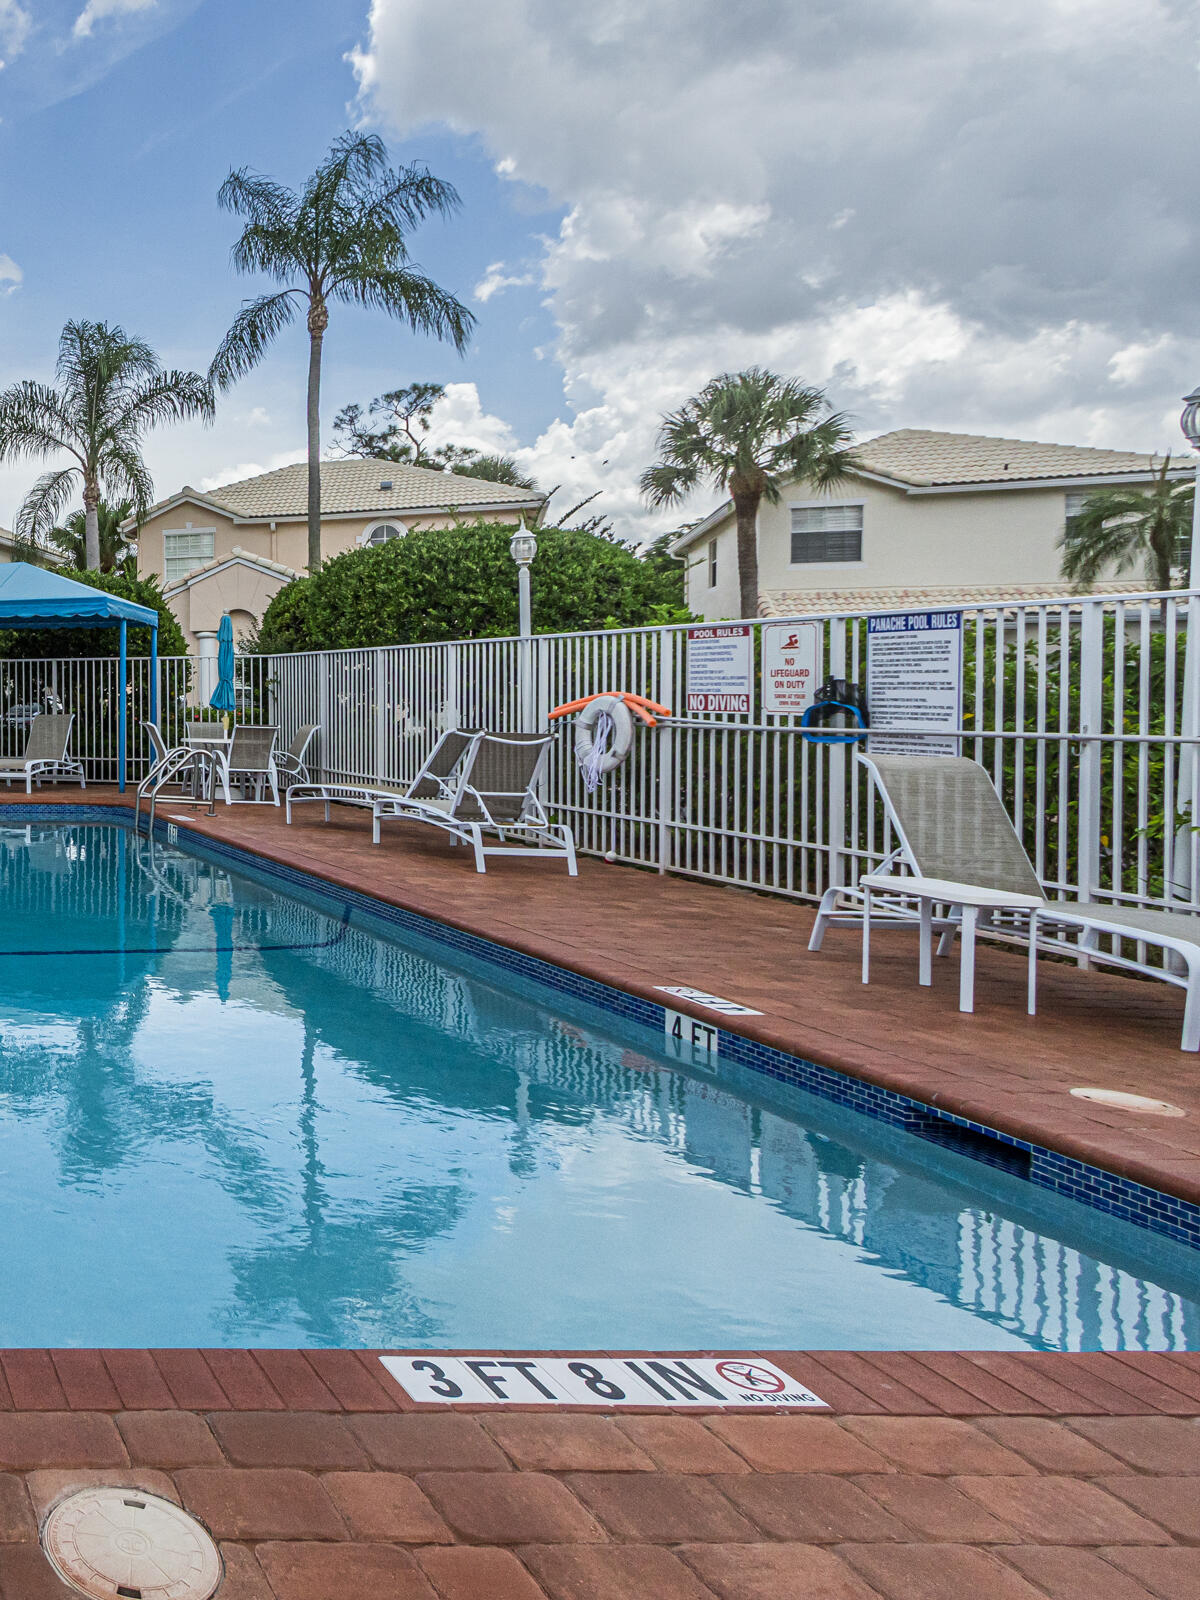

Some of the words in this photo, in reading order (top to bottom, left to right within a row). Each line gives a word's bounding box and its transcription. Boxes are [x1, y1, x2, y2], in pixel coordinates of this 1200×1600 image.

[870, 616, 906, 632] PANACHE
[908, 615, 929, 630] POOL
[931, 613, 958, 628] RULES
[693, 629, 715, 638] POOL
[716, 627, 744, 637] RULES
[784, 657, 795, 666] NO
[770, 668, 810, 678] LIFEGUARD
[774, 680, 785, 689] ON
[786, 680, 806, 689] DUTY
[689, 694, 705, 711] NO
[707, 694, 748, 711] DIVING
[672, 1015, 683, 1040] 4
[691, 1021, 716, 1052] FT
[411, 1359, 464, 1399] 3
[463, 1360, 559, 1400] FT
[567, 1361, 627, 1401] 8
[623, 1361, 728, 1401] IN
[738, 1393, 764, 1402] NO
[763, 1393, 816, 1402] DIVING
